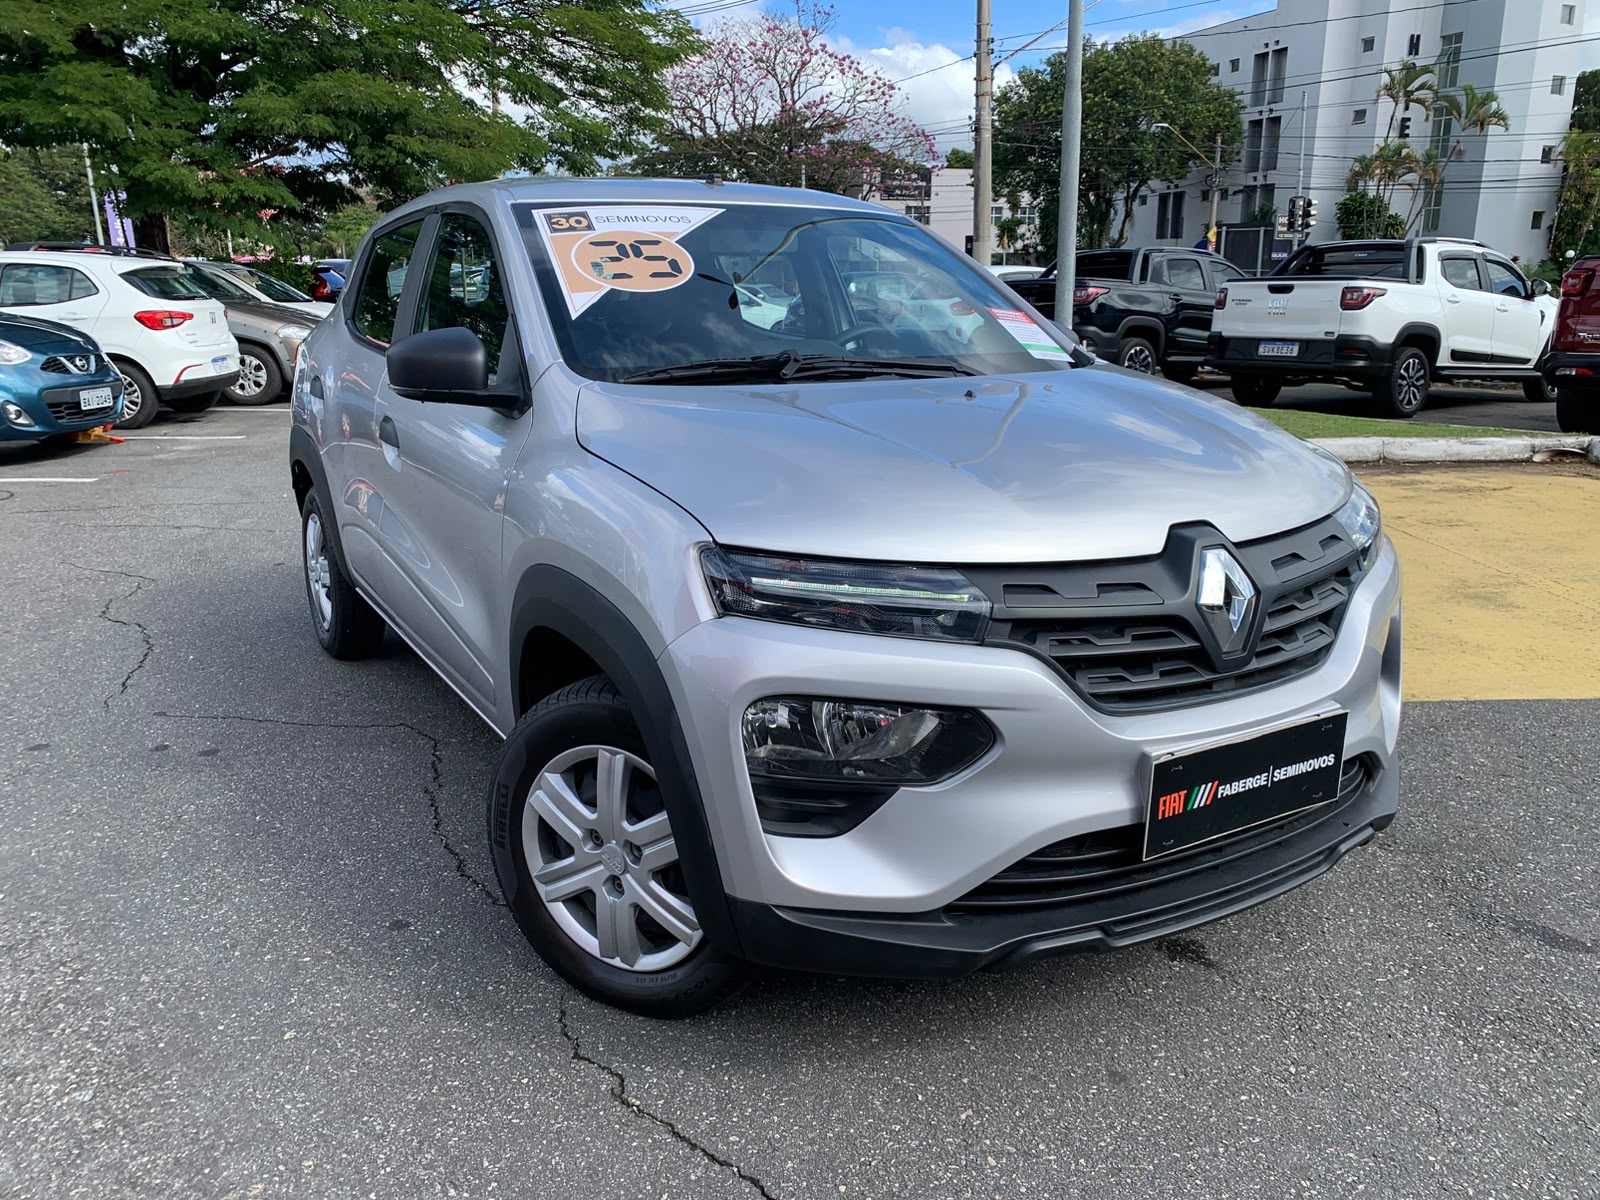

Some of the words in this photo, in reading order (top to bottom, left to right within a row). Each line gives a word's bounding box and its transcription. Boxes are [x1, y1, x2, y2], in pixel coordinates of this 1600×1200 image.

[550, 216, 589, 229] 30
[595, 215, 692, 224] SEMINOVOS
[588, 239, 683, 280] 25
[1157, 789, 1187, 820] FIAT
[1217, 772, 1268, 799] FABERGE
[1273, 753, 1335, 782] SEMINOVOS
